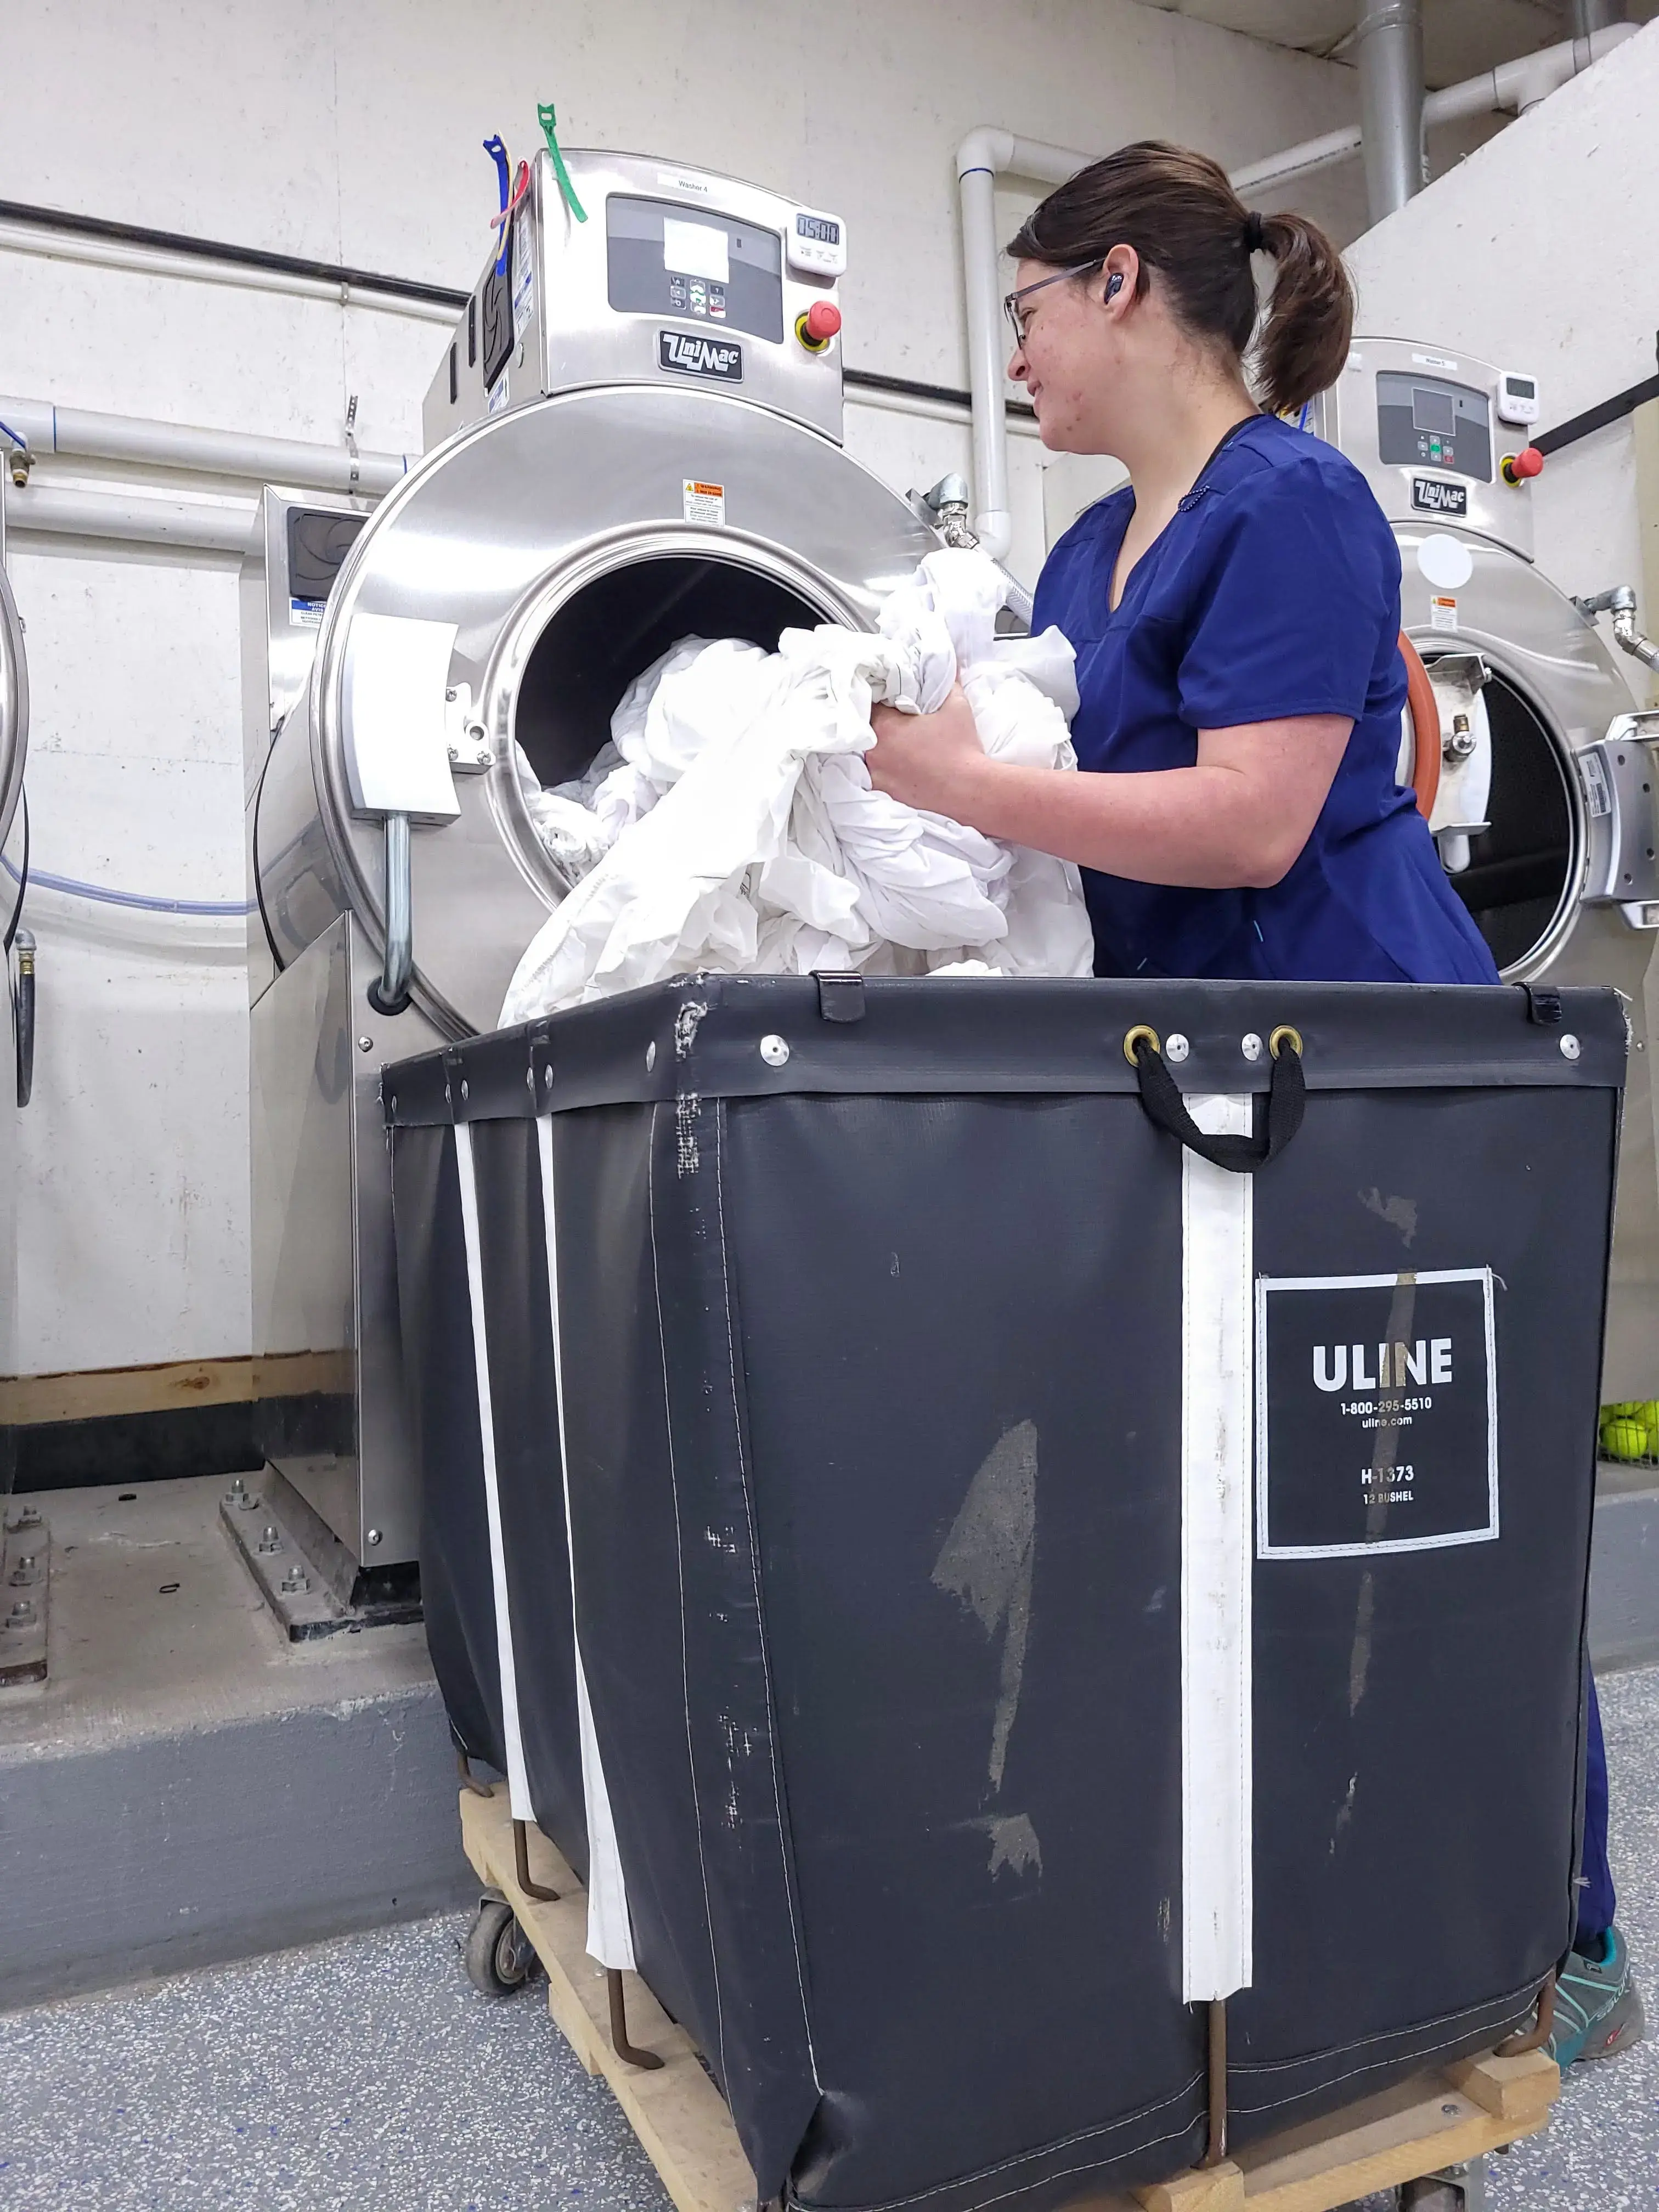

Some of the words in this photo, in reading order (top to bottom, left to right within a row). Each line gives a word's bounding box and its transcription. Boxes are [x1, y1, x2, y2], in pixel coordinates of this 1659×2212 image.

[679, 180, 702, 191] Washer
[798, 217, 837, 244] 05:00
[663, 334, 739, 372] UniMac
[1415, 480, 1465, 509] UniMac
[1313, 1338, 1452, 1392] ULINE
[1340, 1397, 1432, 1415] 1-800-295-5510
[1362, 1415, 1413, 1429] uline.com
[1361, 1465, 1414, 1484] H-1373
[1363, 1493, 1376, 1505] 12
[1378, 1490, 1414, 1503] BUSHEL
